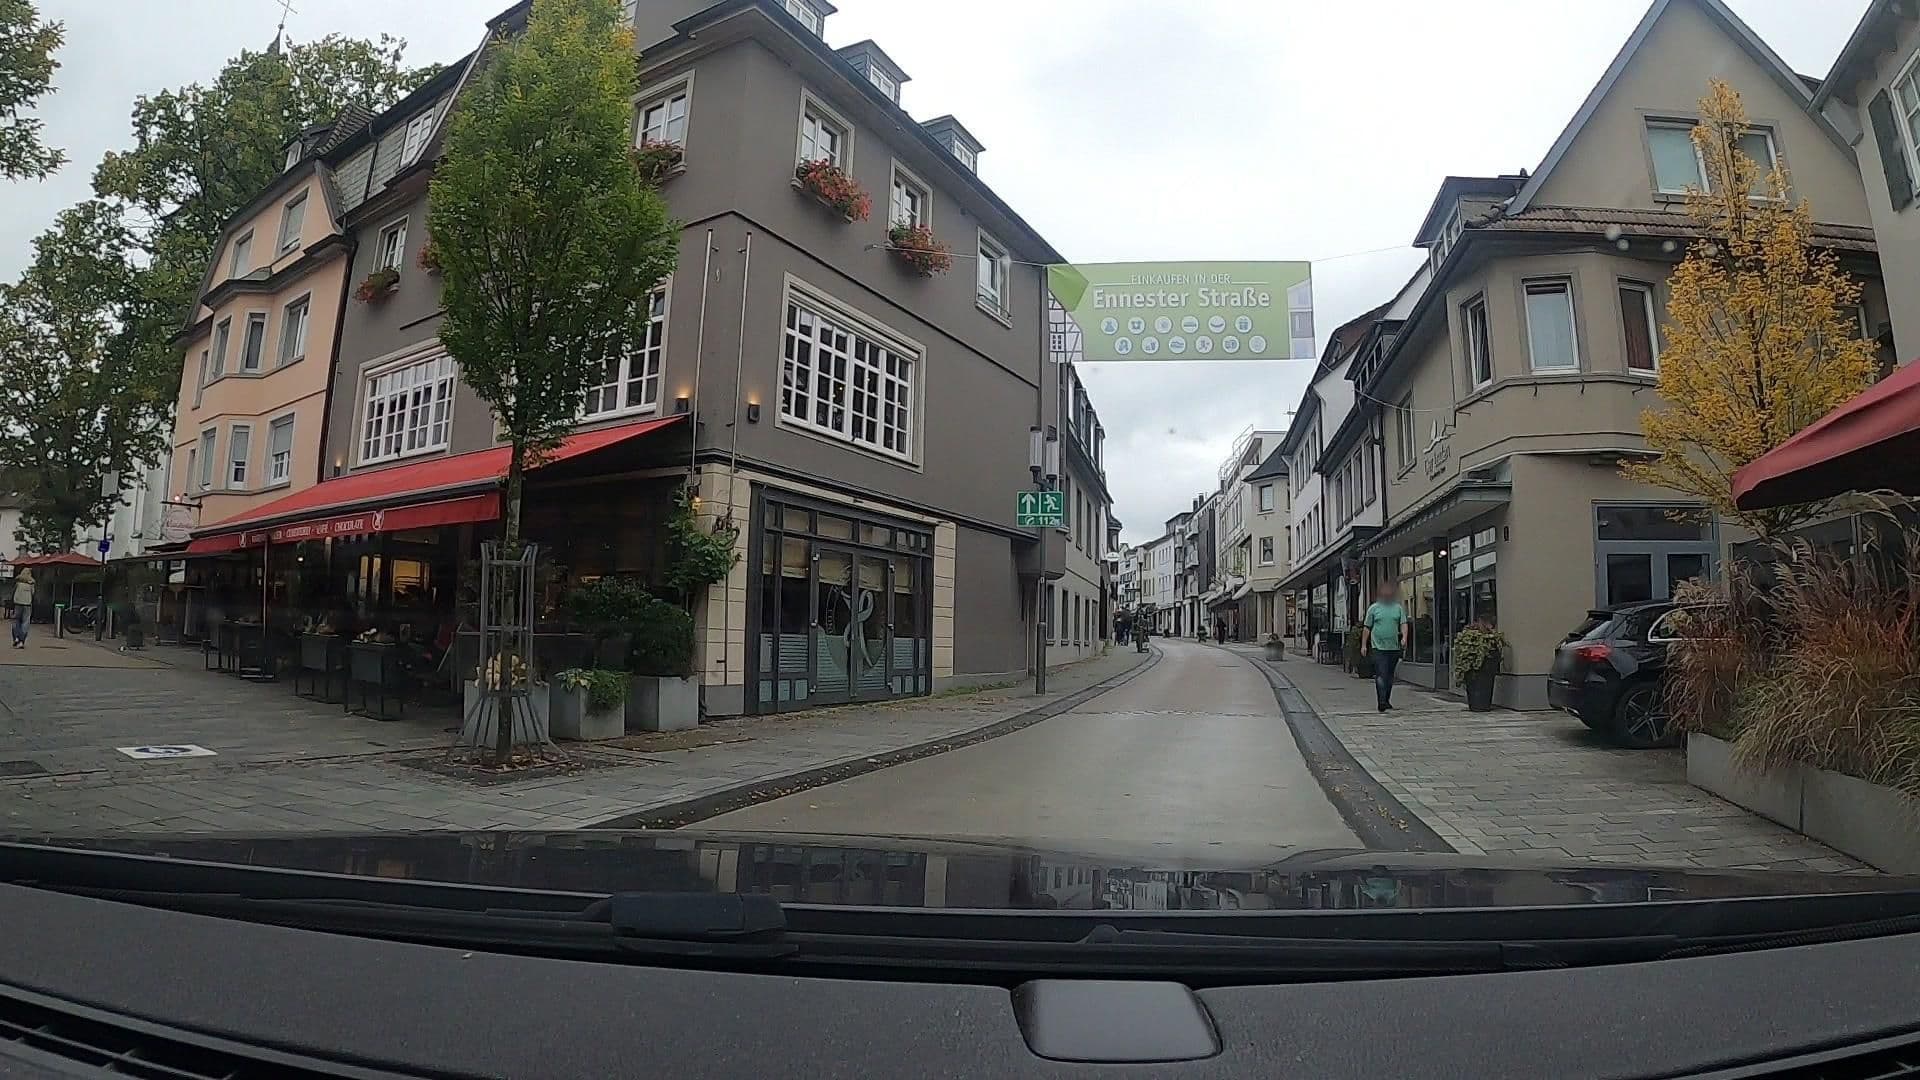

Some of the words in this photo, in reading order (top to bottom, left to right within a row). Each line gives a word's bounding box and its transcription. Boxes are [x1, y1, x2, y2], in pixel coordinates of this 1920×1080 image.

[1131, 273, 1190, 285] EINKAUFEN
[1195, 273, 1206, 284] IN
[1211, 273, 1232, 284] DER
[1093, 288, 1189, 309] Ennester
[1199, 287, 1271, 308] Straße
[1039, 516, 1055, 525] 112
